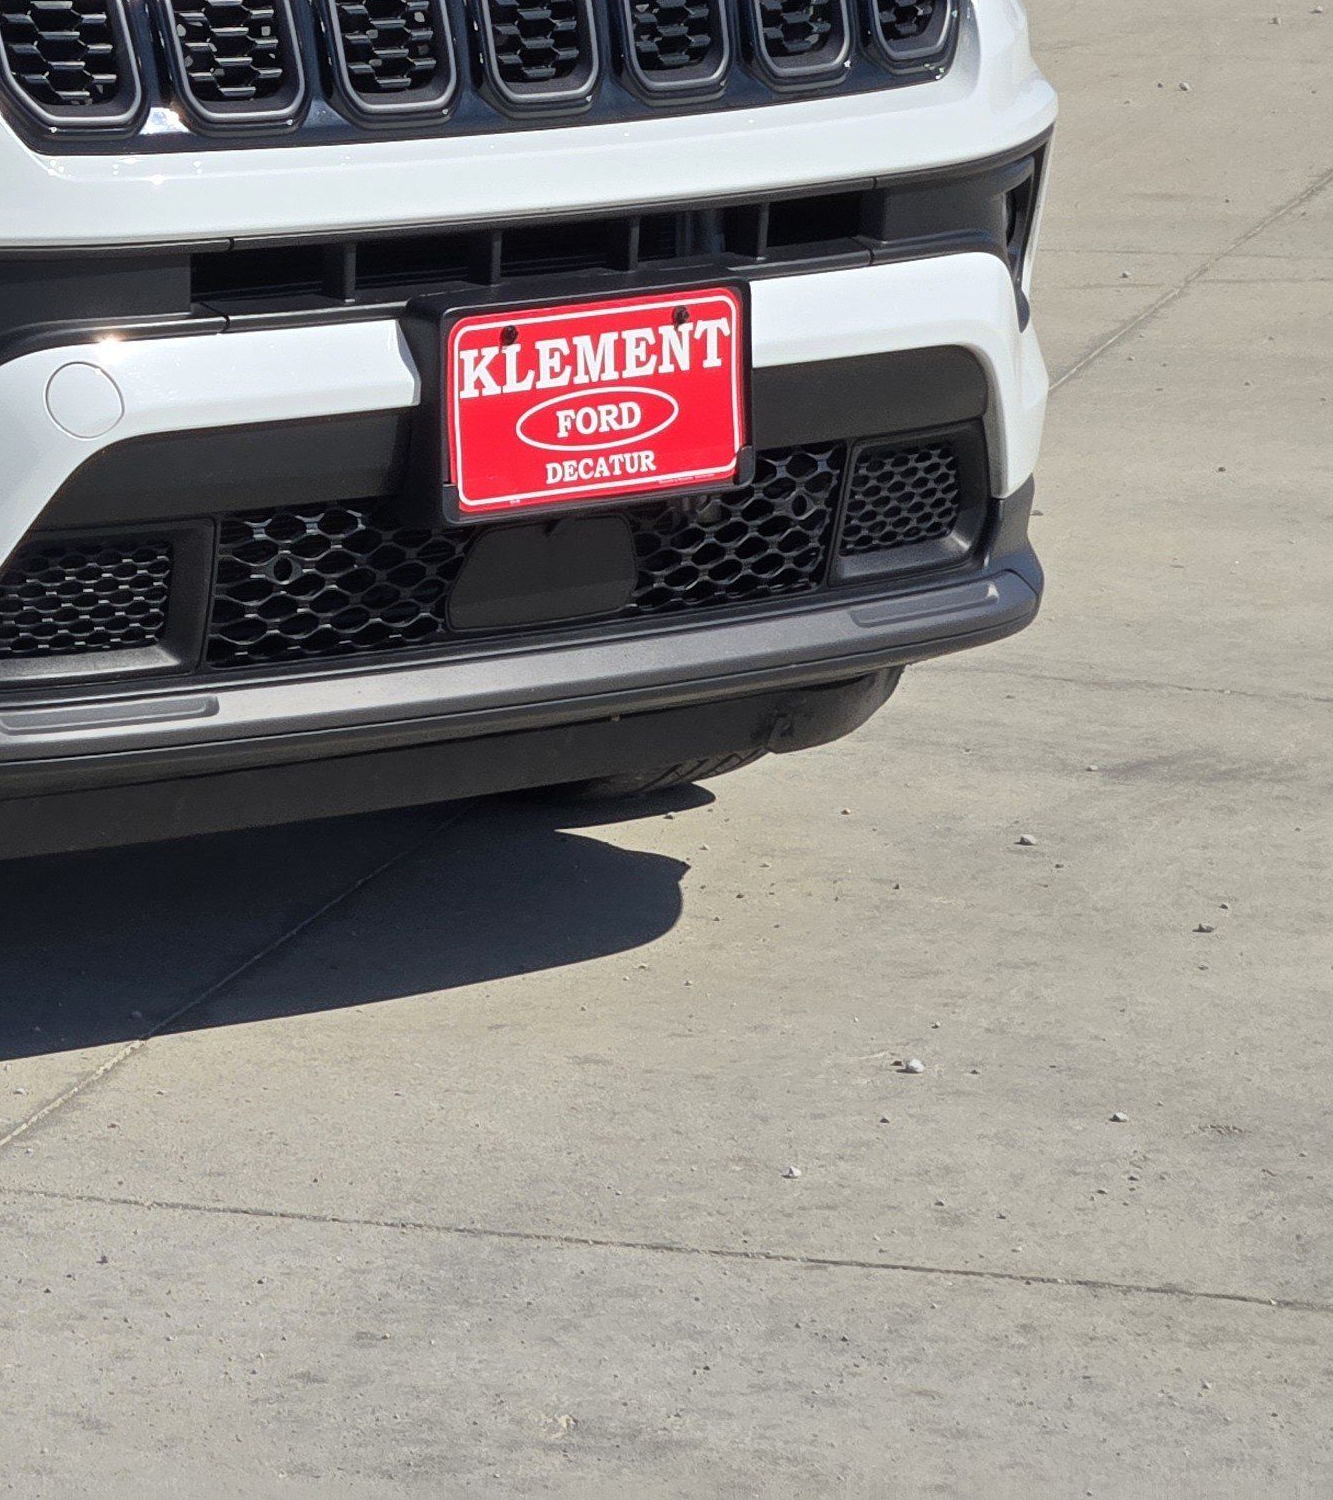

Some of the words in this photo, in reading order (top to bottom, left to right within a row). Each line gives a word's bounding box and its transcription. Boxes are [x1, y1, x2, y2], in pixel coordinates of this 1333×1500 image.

[460, 317, 730, 399] KLEMENT
[556, 401, 642, 438] FORD
[546, 450, 656, 485] DECATUR
